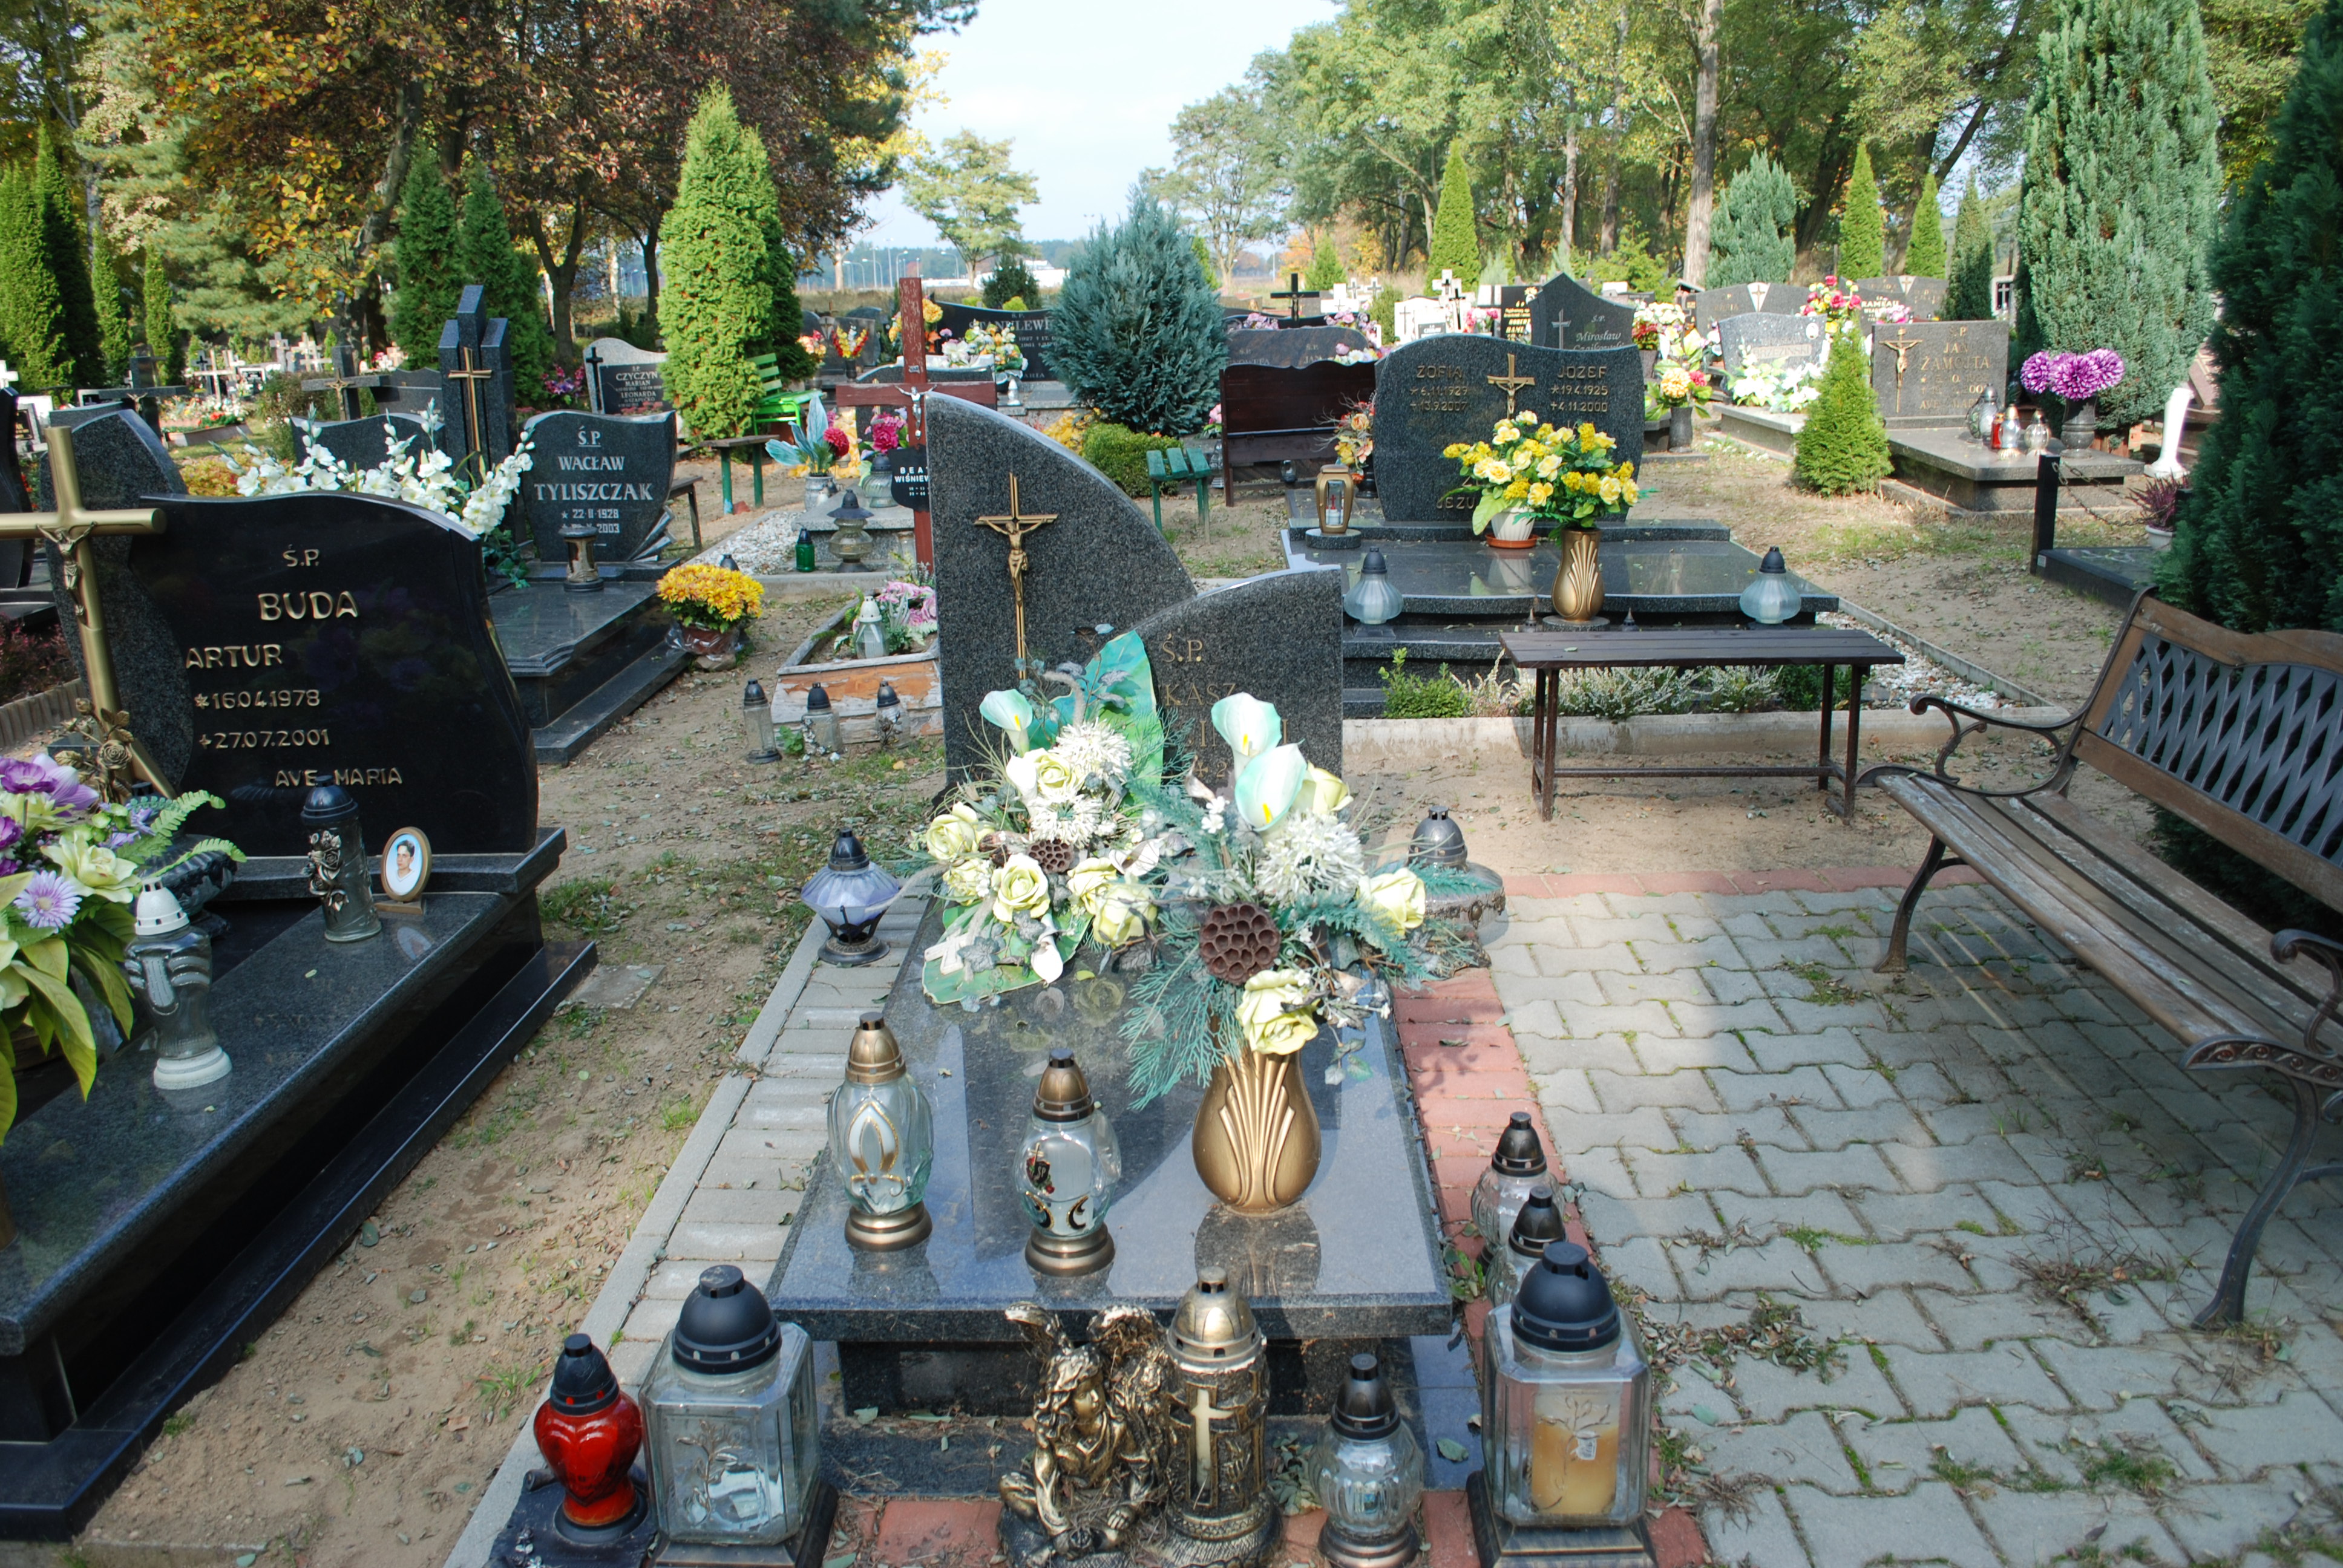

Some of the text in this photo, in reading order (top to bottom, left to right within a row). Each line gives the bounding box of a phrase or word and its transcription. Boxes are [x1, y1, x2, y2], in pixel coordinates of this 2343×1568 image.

[1576, 330, 1622, 342] Mirosław
[1417, 365, 1462, 378] ZOFIA
[558, 456, 624, 471] WACŁAW
[534, 483, 654, 501] TYLISZCZAK
[283, 544, 320, 567] Ś.P.
[258, 590, 358, 621] BUDA
[186, 644, 283, 668] ARTUR
[1162, 633, 1203, 663] Ś.P.
[1158, 683, 1236, 707] KASZ
[276, 767, 402, 786] AVE MARIA
